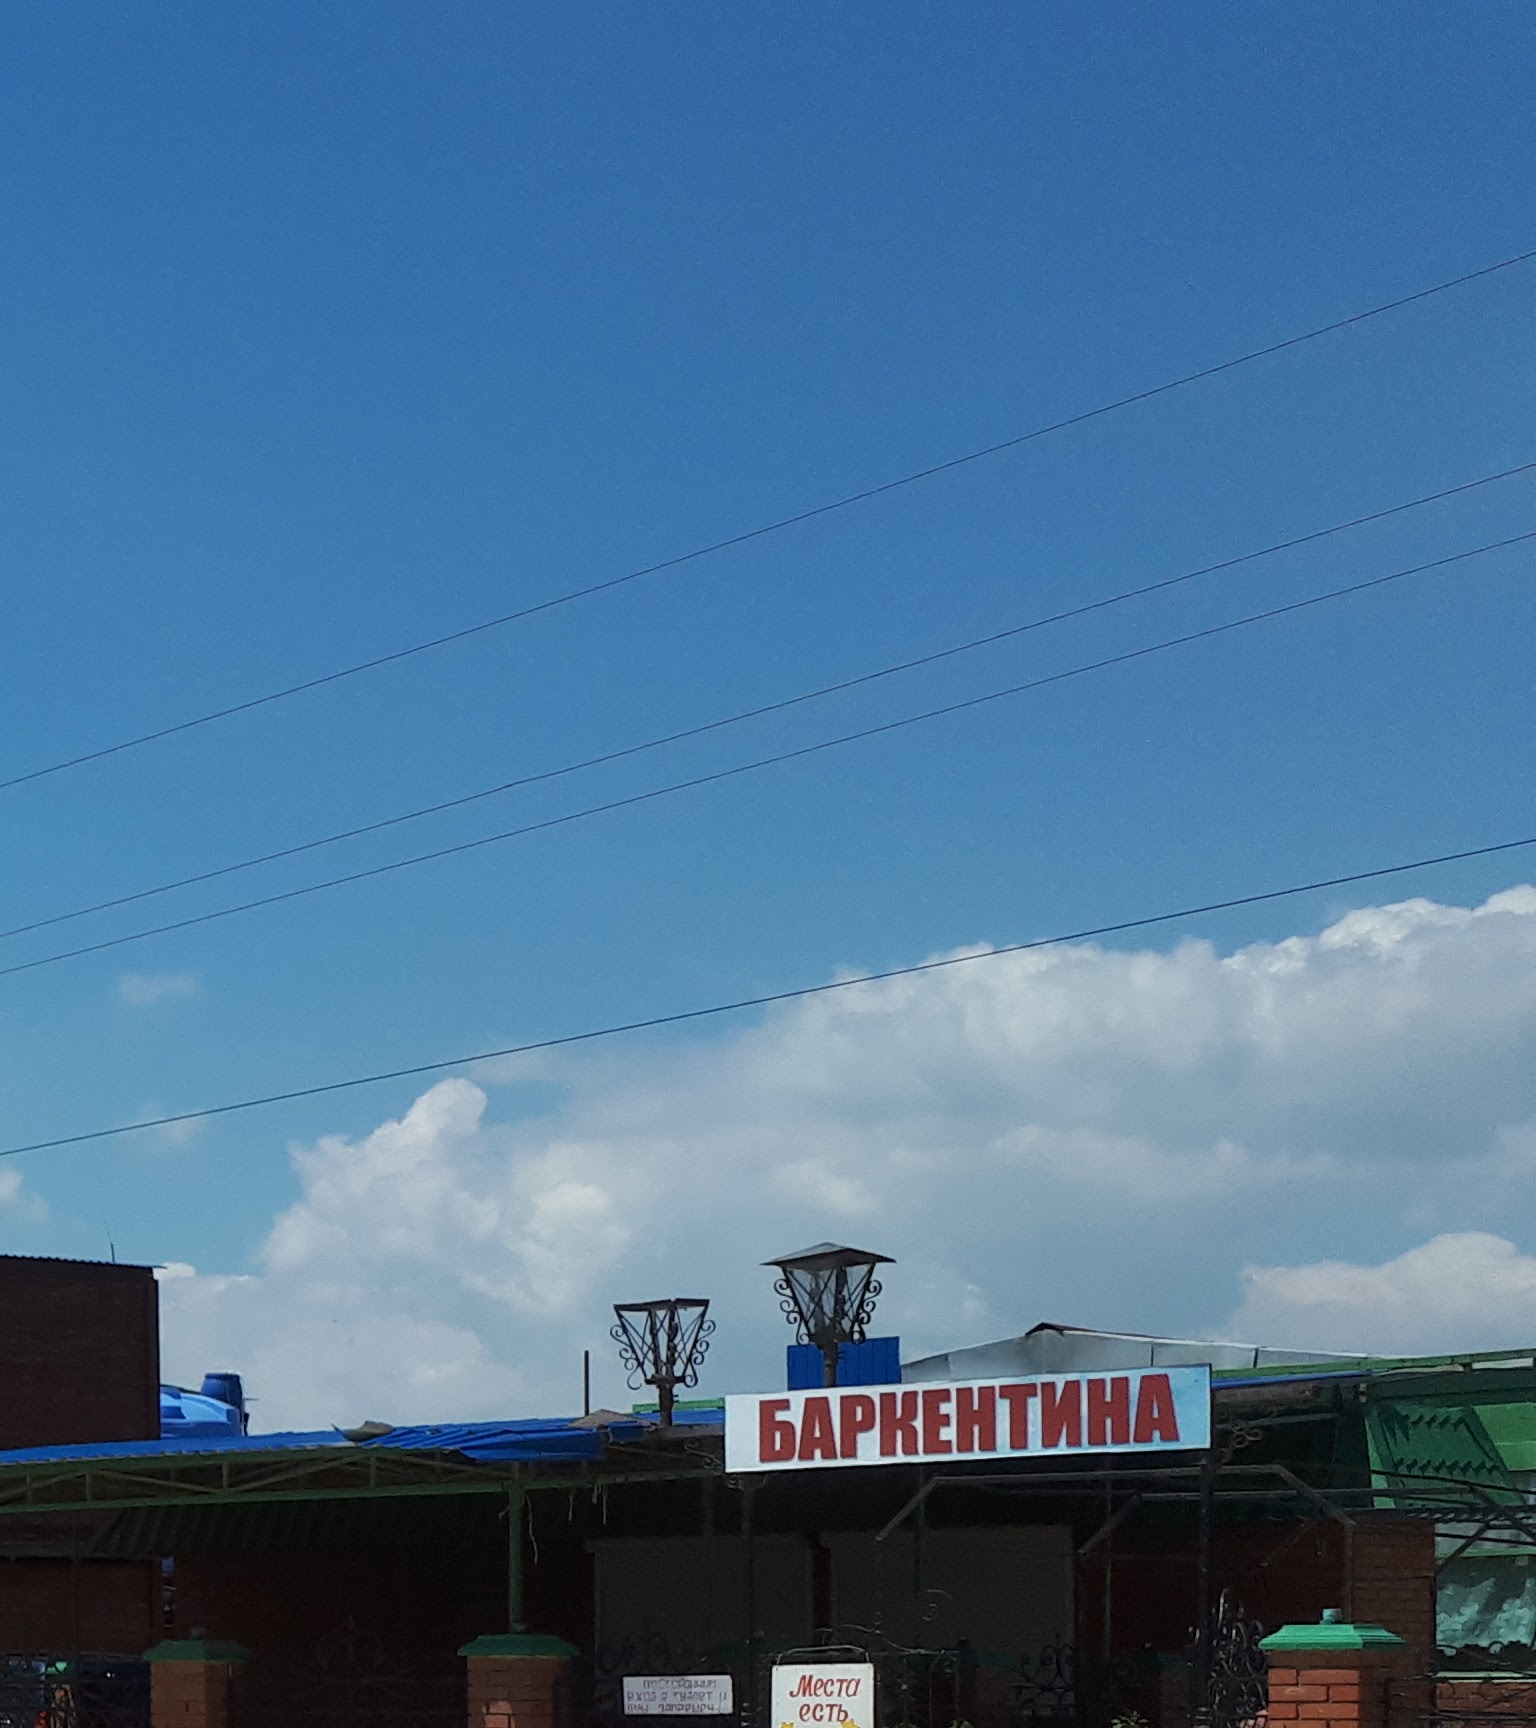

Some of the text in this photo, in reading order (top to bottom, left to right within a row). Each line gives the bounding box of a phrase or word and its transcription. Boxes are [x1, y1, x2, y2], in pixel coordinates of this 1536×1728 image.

[759, 1373, 1180, 1463] БАРКЕНТИНА
[789, 1675, 862, 1698] Места
[799, 1703, 849, 1722] есть
